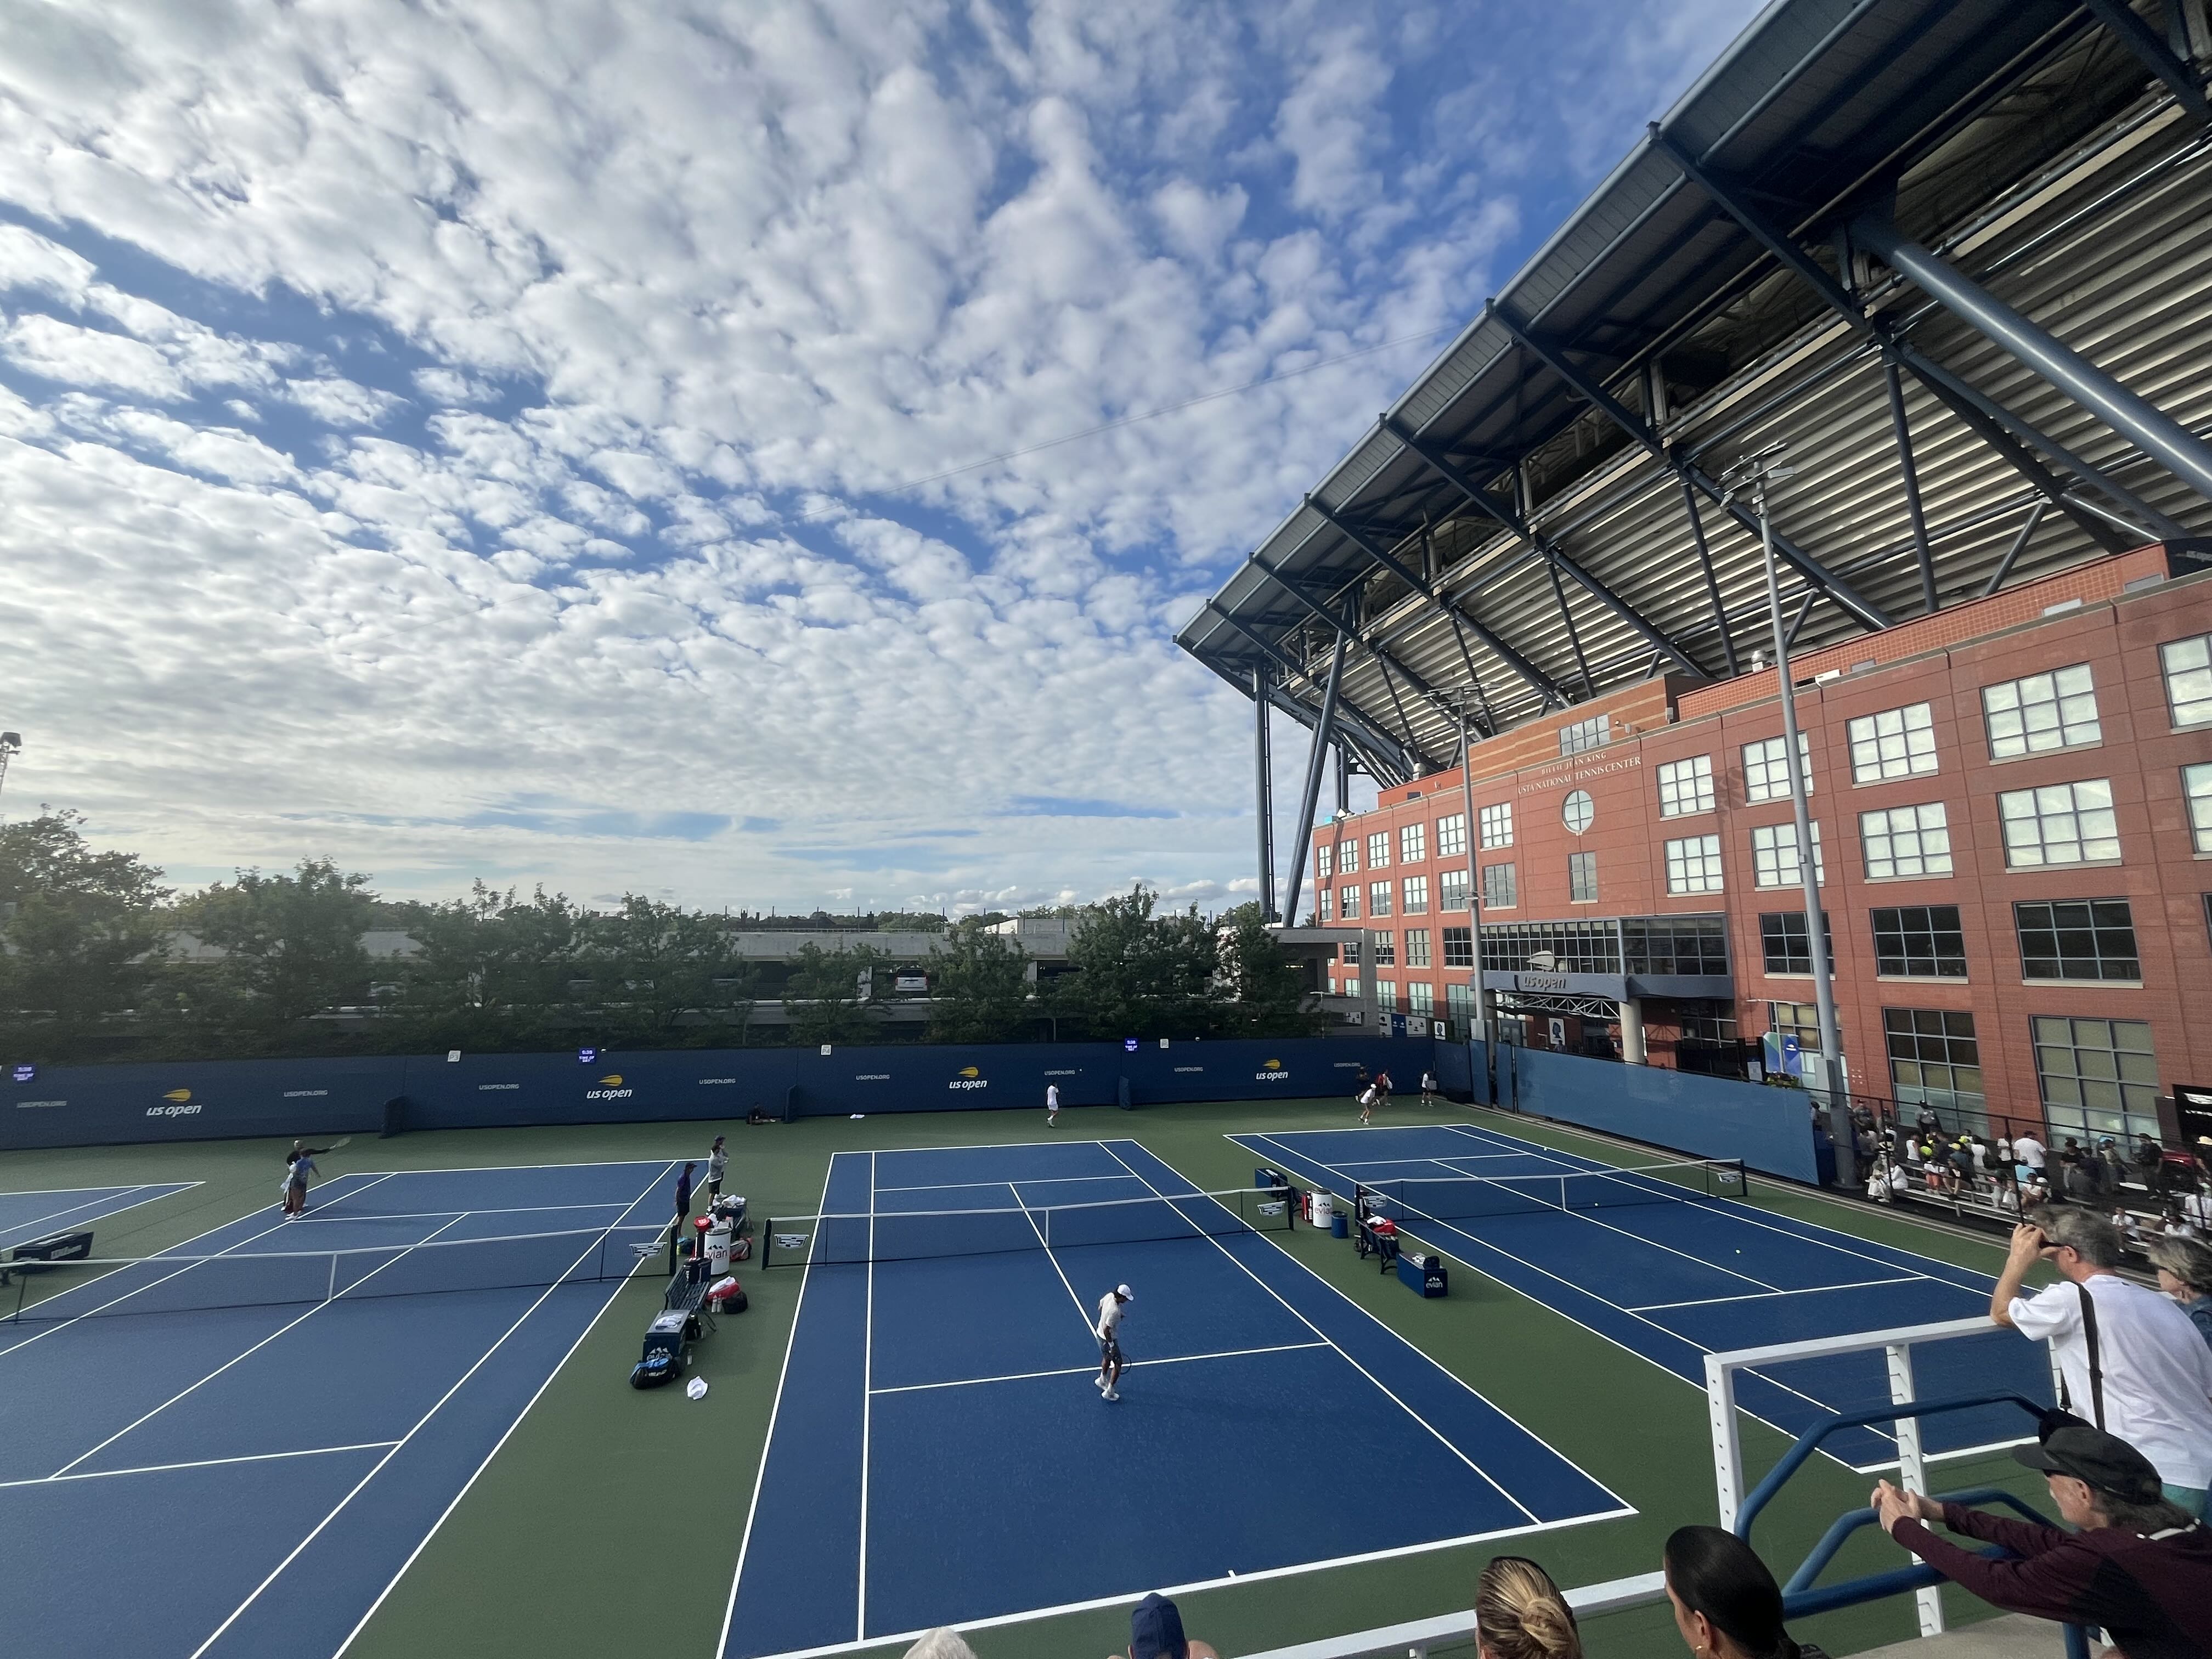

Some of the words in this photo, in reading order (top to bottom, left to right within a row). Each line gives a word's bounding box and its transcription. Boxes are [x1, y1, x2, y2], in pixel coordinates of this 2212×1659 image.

[1587, 752, 1606, 763] KING
[1518, 784, 1535, 794] USTA
[1536, 774, 1572, 790] NATIONAL
[1575, 766, 1604, 780] TENNIS
[1605, 757, 1641, 772] CENTER
[1267, 1071, 1288, 1081] open
[962, 1080, 987, 1090] open
[586, 1090, 601, 1099] us
[602, 1089, 632, 1100] open
[146, 1107, 165, 1116] us
[165, 1105, 202, 1118] open
